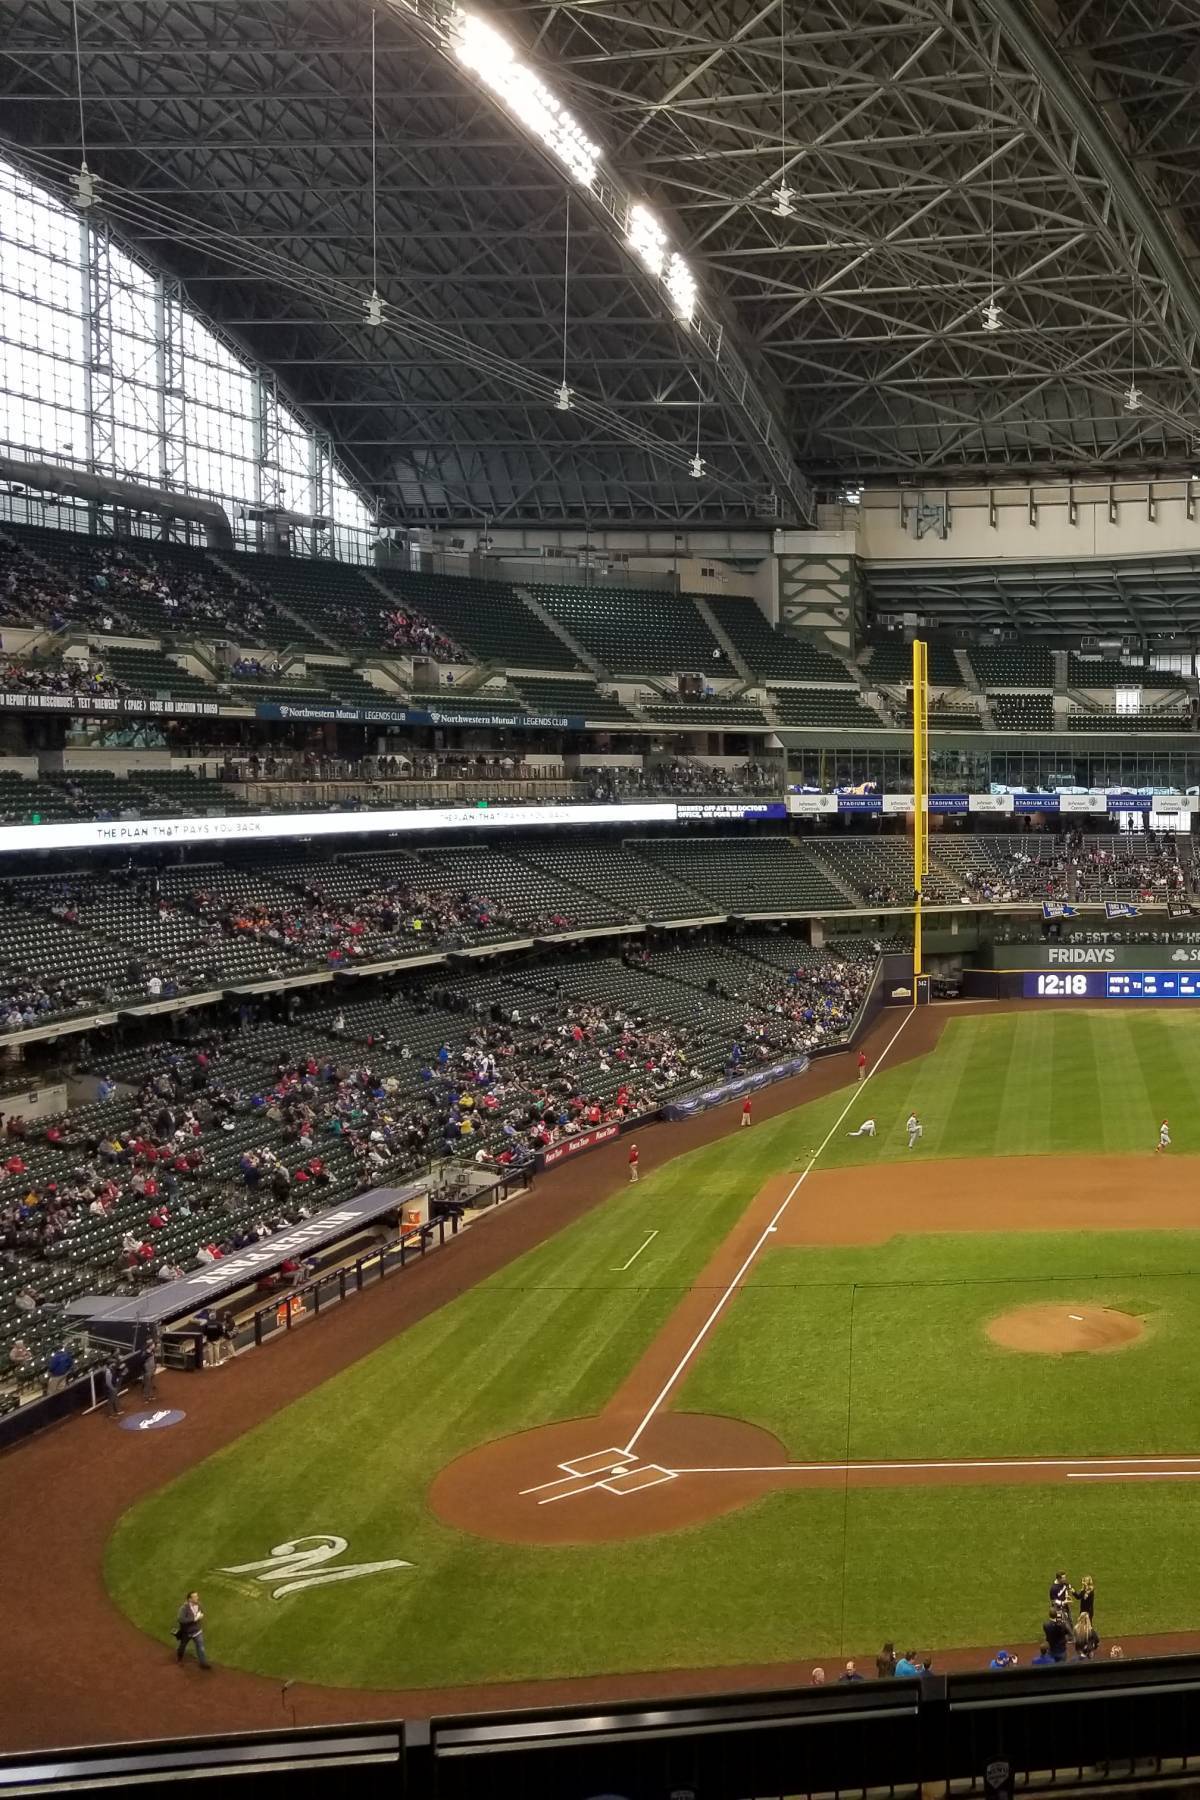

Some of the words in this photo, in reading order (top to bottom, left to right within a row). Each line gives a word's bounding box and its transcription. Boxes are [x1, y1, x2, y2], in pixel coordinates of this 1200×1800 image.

[78, 698, 91, 709] TEXT
[289, 709, 335, 719] Northwestern
[336, 710, 359, 719] Mutual
[364, 711, 391, 720] LEGENDS
[391, 712, 406, 721] CLUB
[440, 715, 490, 724] Northwestern
[491, 716, 517, 725] Mutual
[523, 717, 551, 726] LEGENDS
[551, 718, 568, 727] CLUB
[97, 828, 117, 838] THE
[120, 827, 148, 838] PLAN
[153, 825, 179, 836] THAT
[183, 824, 210, 834] PAYS
[236, 823, 261, 832] BACK
[1048, 948, 1116, 963] FRIDAYS
[1037, 974, 1087, 995] 12:18
[259, 1211, 364, 1251] MILLER
[188, 1253, 276, 1285] PARK
